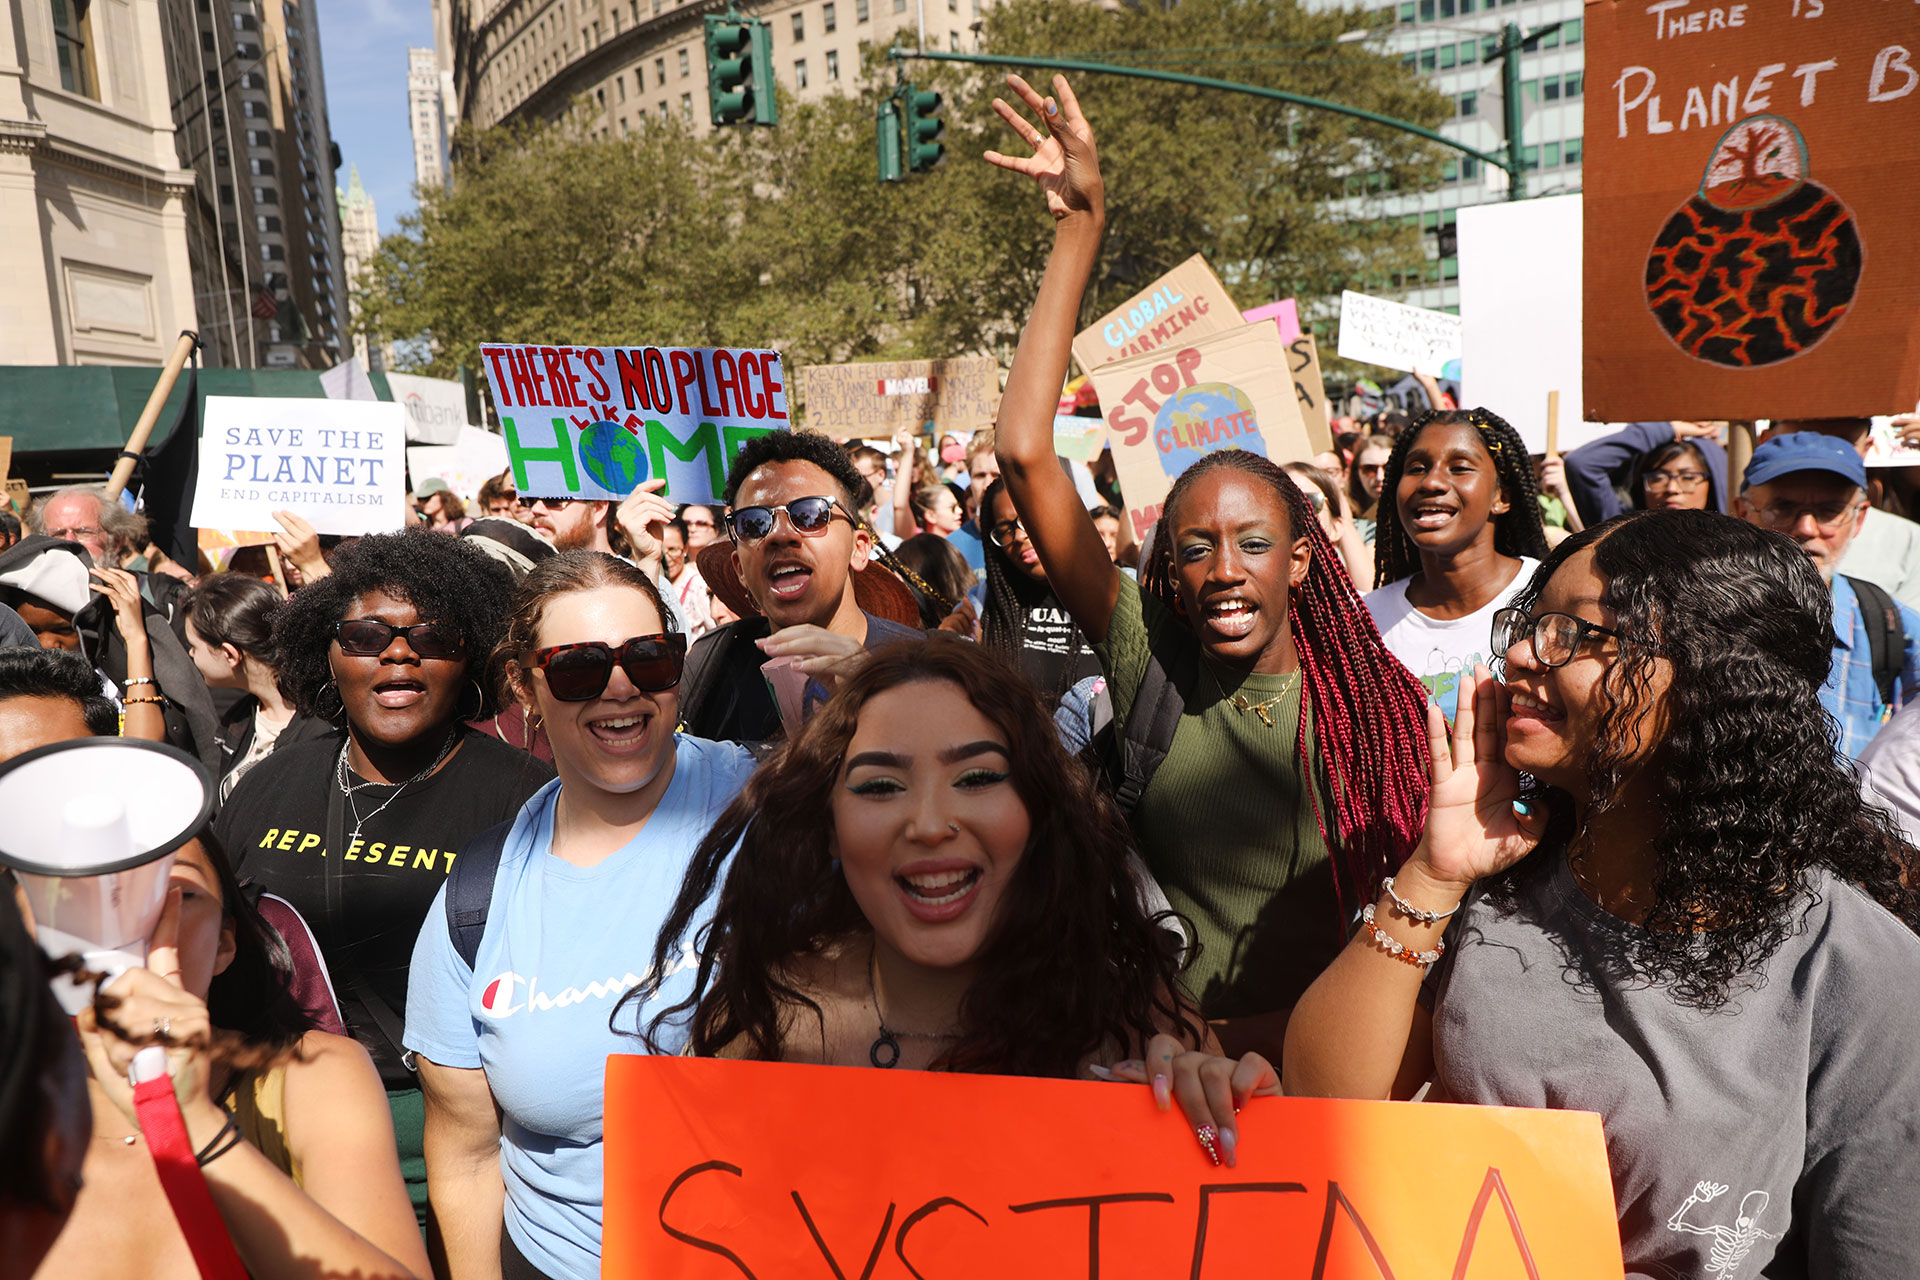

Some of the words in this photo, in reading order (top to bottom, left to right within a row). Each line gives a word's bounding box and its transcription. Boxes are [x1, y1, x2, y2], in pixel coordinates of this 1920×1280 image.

[1646, 0, 1748, 40] THERE
[1612, 57, 1838, 138] PLANET
[1867, 45, 1919, 102] B
[1103, 285, 1184, 347] GLOBAL
[1107, 296, 1210, 361] ARMING
[484, 347, 611, 408] THERE'S
[614, 346, 673, 414] NO
[670, 349, 787, 420] PLACE
[807, 381, 833, 395] MORE
[836, 378, 875, 395] PLANNED
[884, 377, 931, 396] MARVEL
[944, 374, 985, 391] MOVIES
[808, 364, 853, 382] KEVIN
[858, 363, 897, 380] FEIGE
[899, 362, 926, 378] SAID
[977, 359, 996, 374] 20
[807, 395, 837, 411] AFTER
[812, 411, 826, 426] 2
[829, 409, 853, 426] DIE
[858, 408, 897, 424] BEFORE
[1108, 348, 1202, 446] STOP
[225, 427, 303, 447] SAVE
[318, 429, 384, 450] THE
[570, 404, 645, 435] LIKE
[1156, 410, 1256, 453] CLIMATE
[222, 453, 384, 486] PLANET
[220, 488, 260, 501] END
[268, 491, 384, 505] CAPITALISM
[259, 828, 457, 874] REPESENT
[480, 941, 703, 1019] Champi
